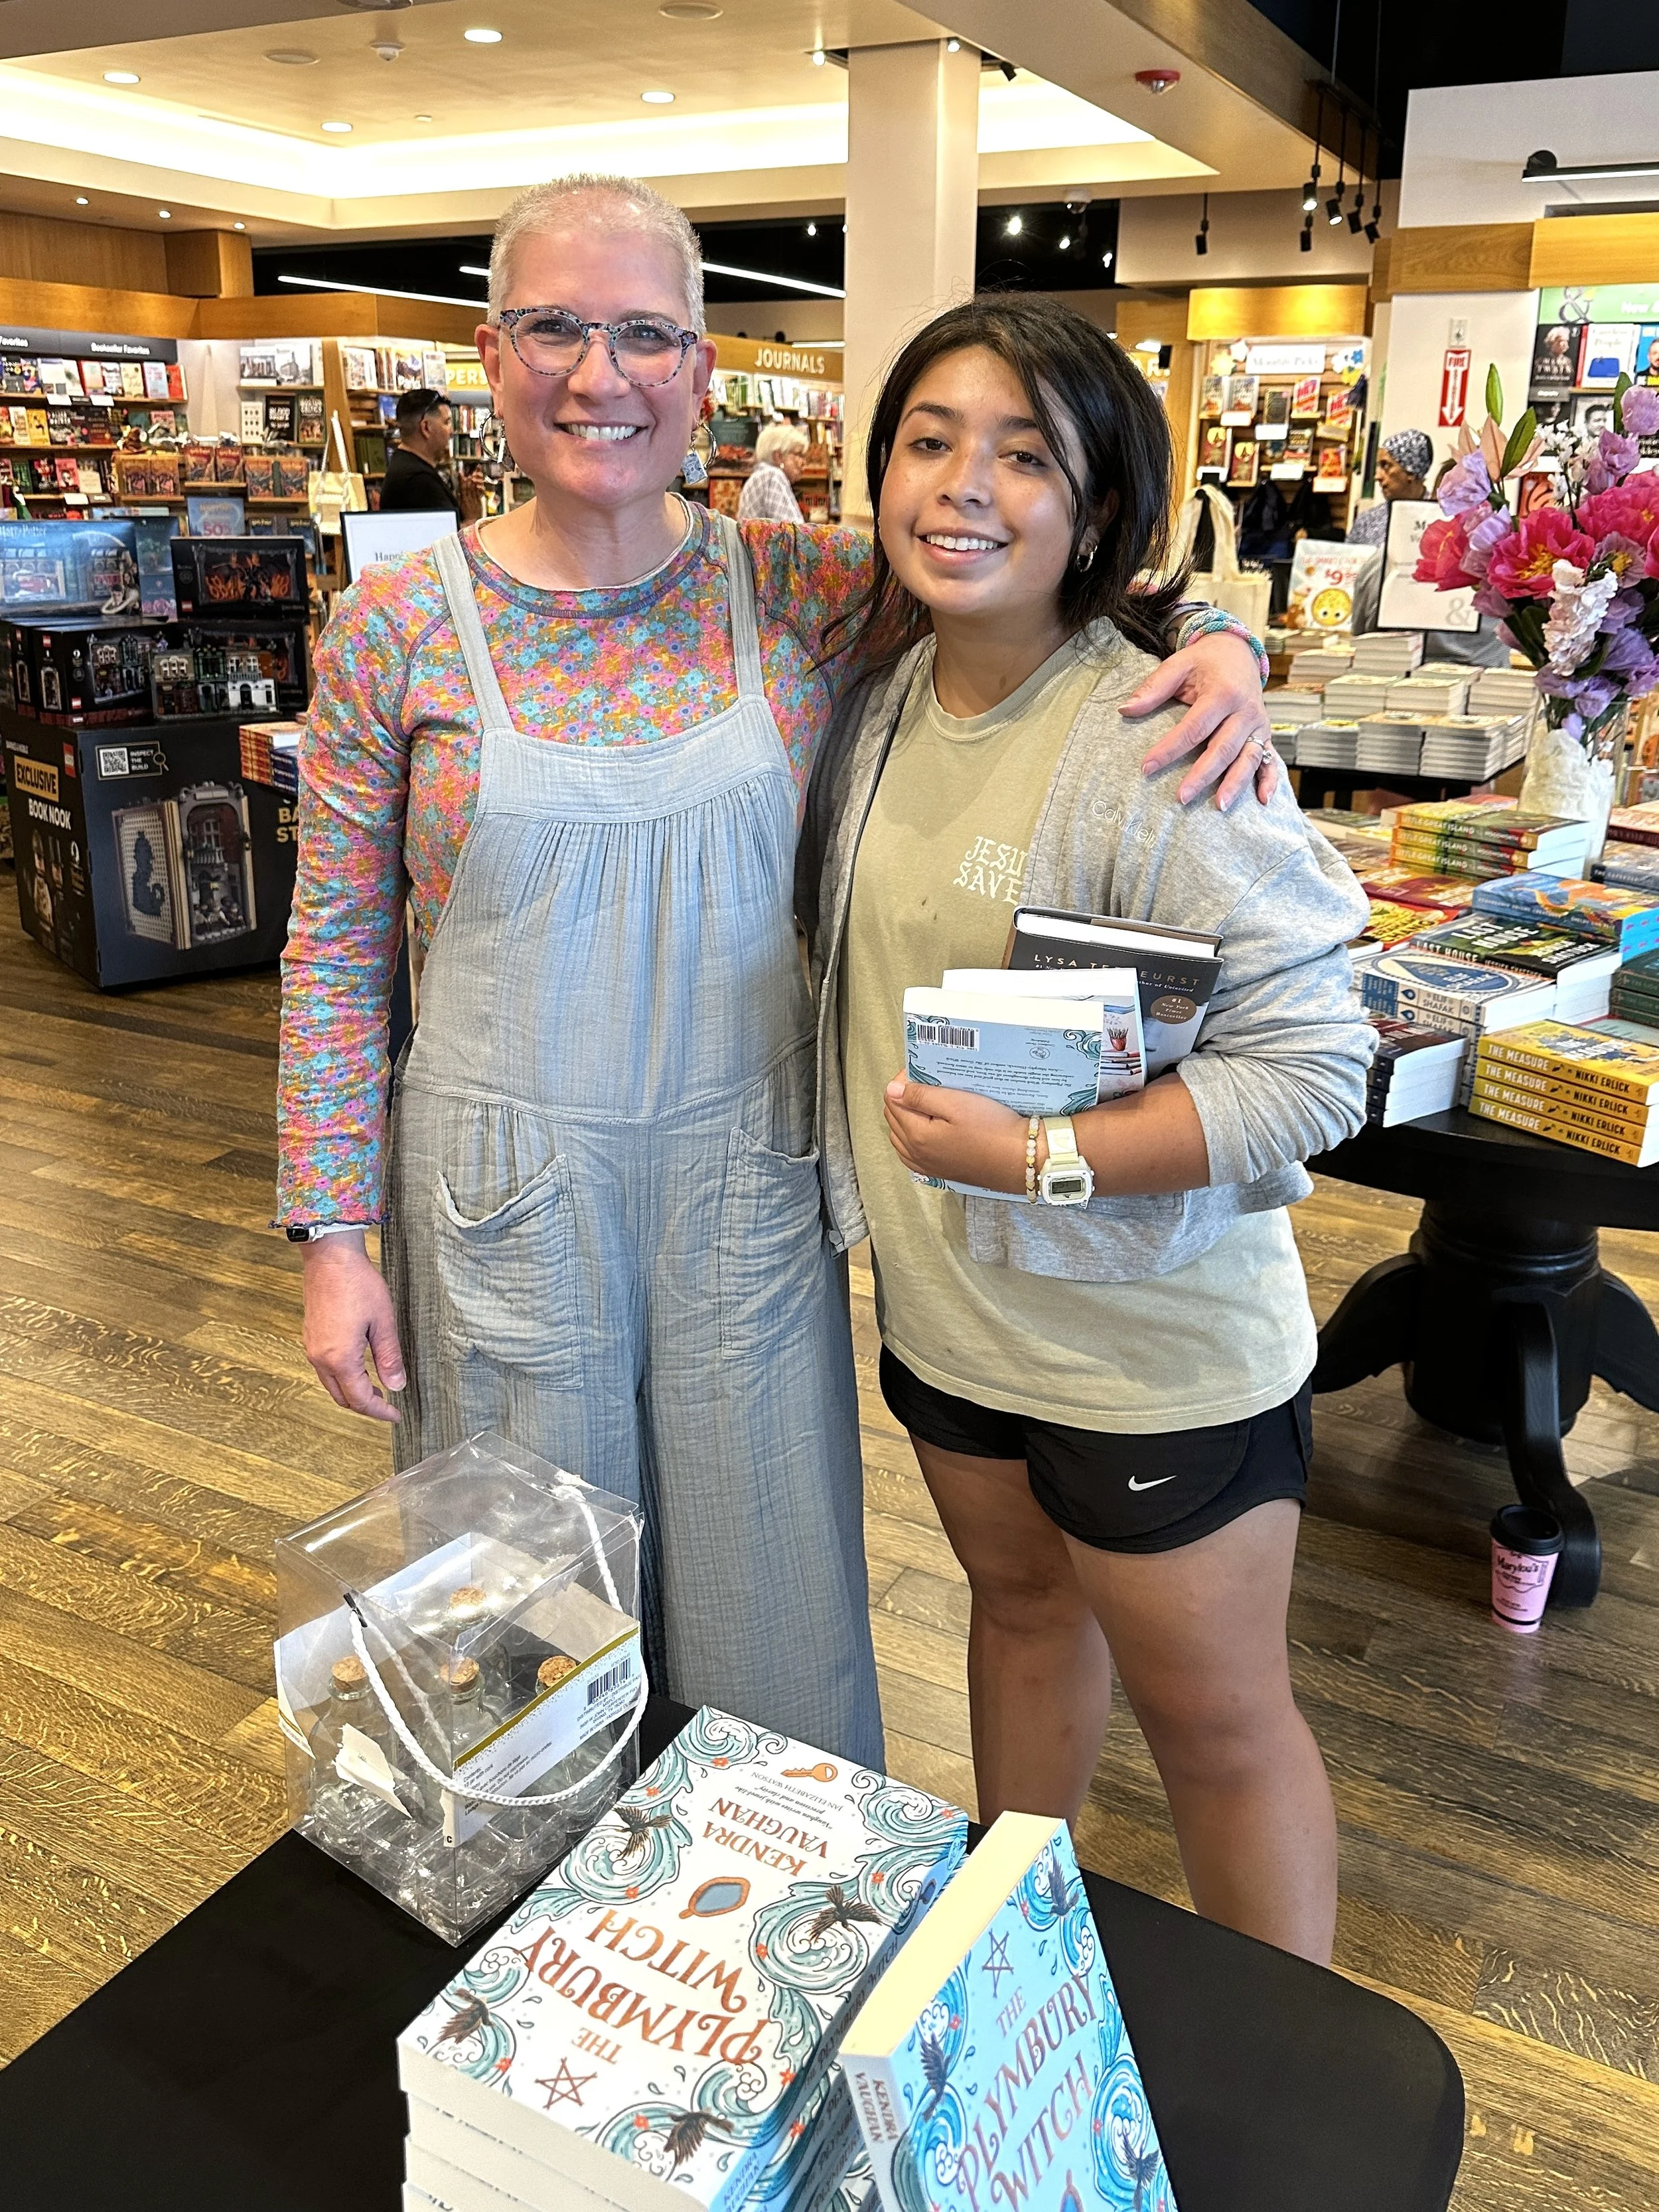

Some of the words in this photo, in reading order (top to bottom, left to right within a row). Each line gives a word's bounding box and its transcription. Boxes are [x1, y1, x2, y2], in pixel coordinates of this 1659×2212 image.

[755, 348, 826, 374] JOURNALS
[1446, 598, 1472, 626] &
[17, 763, 57, 794] EXCLUSIVE
[29, 798, 48, 822] BOOK
[49, 806, 71, 830] NOOK
[278, 806, 299, 824] BA
[1424, 818, 1447, 830] GREAT
[1447, 824, 1475, 835] ISLAND
[276, 826, 298, 843] ST
[1417, 834, 1440, 846] GREAT
[1441, 840, 1468, 852] ISLAND
[965, 836, 1029, 877] JESU
[1417, 851, 1439, 863] GREAT
[1441, 857, 1468, 869] ISLAND
[953, 861, 1024, 907] SAVE
[1451, 922, 1505, 940] LAST
[1471, 926, 1540, 950] HOUSE
[1415, 940, 1442, 954] LAST
[1445, 948, 1479, 963] HOUSE
[1034, 954, 1078, 967] LYSA
[1090, 962, 1200, 986] TEURST
[1423, 998, 1455, 1014] SHAFAK
[1433, 994, 1447, 1002] ELIF
[1156, 1011, 1188, 1020] Bestseller
[1433, 1014, 1447, 1023] ELIF
[1488, 1044, 1504, 1059] THE
[1506, 1049, 1549, 1071] MEASURE
[1575, 1069, 1599, 1084] NIKKI
[1601, 1076, 1630, 1094] ERLICK
[1486, 1063, 1502, 1078] THE
[1504, 1069, 1547, 1092] MEASURE
[1573, 1090, 1597, 1106] NIKKI
[1599, 1096, 1628, 1114] ERLICK
[1484, 1083, 1500, 1098] THE
[1502, 1088, 1545, 1112] MEASURE
[1571, 1110, 1595, 1126] NIKKI
[1596, 1118, 1626, 1136] ERLICK
[1479, 1102, 1496, 1116] THE
[1497, 1106, 1540, 1131] MEASURE
[1566, 1129, 1591, 1145] NIKKI
[1591, 1136, 1621, 1155] ERLICK
[734, 1785, 767, 1801] jewel-like
[751, 1771, 784, 1789] WATSON
[766, 1797, 782, 1808] with
[780, 1795, 796, 1804] and
[784, 1783, 828, 1806] ELIZABETH
[794, 1801, 826, 1815] precision
[828, 1801, 845, 1812] JAN
[780, 1803, 802, 1815] writes
[707, 1797, 828, 1859] VAUGHAN
[701, 1820, 808, 1877] KENDRA
[585, 1909, 748, 2014] WITCH
[869, 1936, 899, 1988] WITCH
[513, 1925, 770, 2065] PLYMBURY
[996, 1986, 1027, 2038] THE
[571, 2027, 624, 2065] THE
[956, 1972, 1097, 2212] PLYMBURY
[855, 2071, 885, 2144] VAUGHAN
[873, 2078, 899, 2140] KENDRA
[990, 2049, 1094, 2212] WITCH
[723, 2150, 758, 2203] KENDRA
